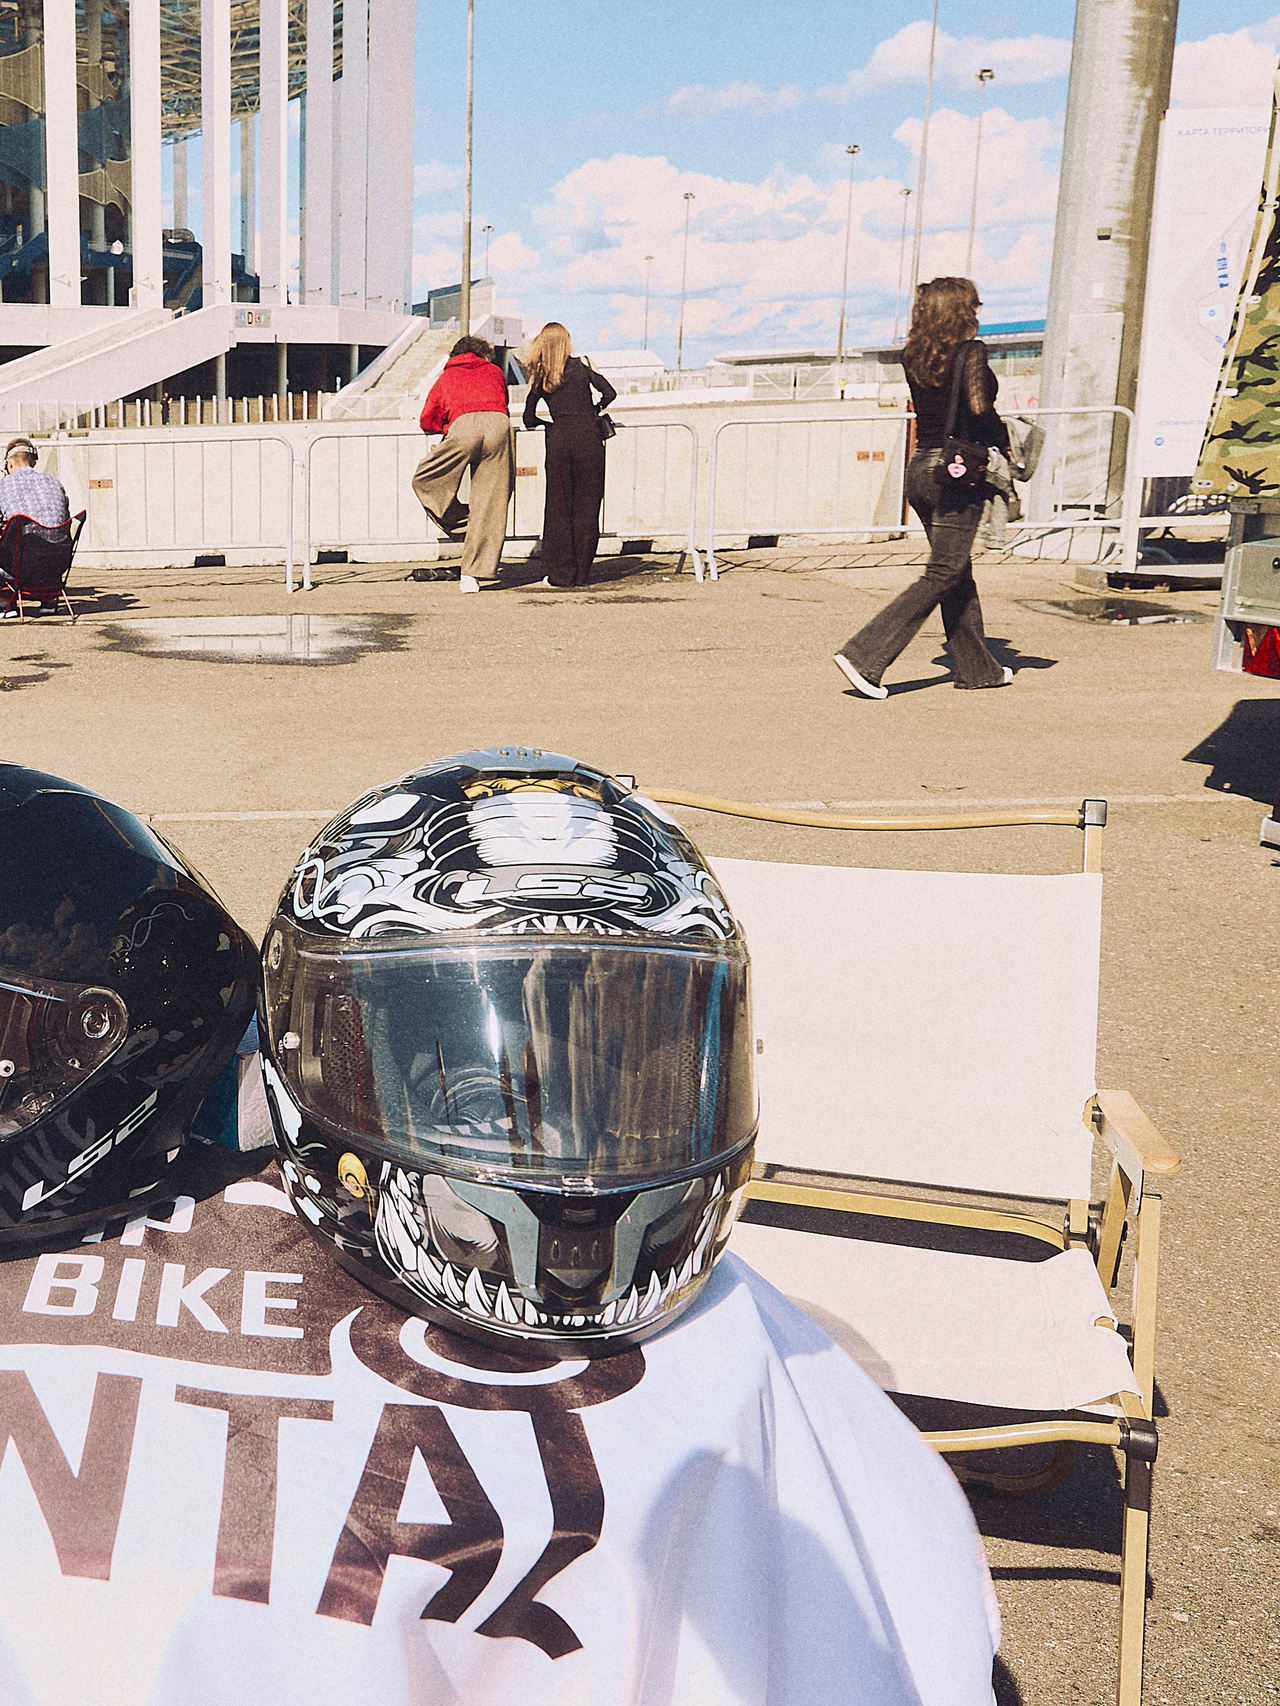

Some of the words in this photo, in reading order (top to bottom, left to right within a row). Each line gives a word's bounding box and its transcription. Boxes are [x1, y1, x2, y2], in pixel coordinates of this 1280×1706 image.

[1178, 128, 1209, 137] КАРТА
[247, 311, 253, 325] D
[454, 873, 649, 905] LS2
[21, 1089, 158, 1212] LS2
[22, 1253, 305, 1340] BIKE
